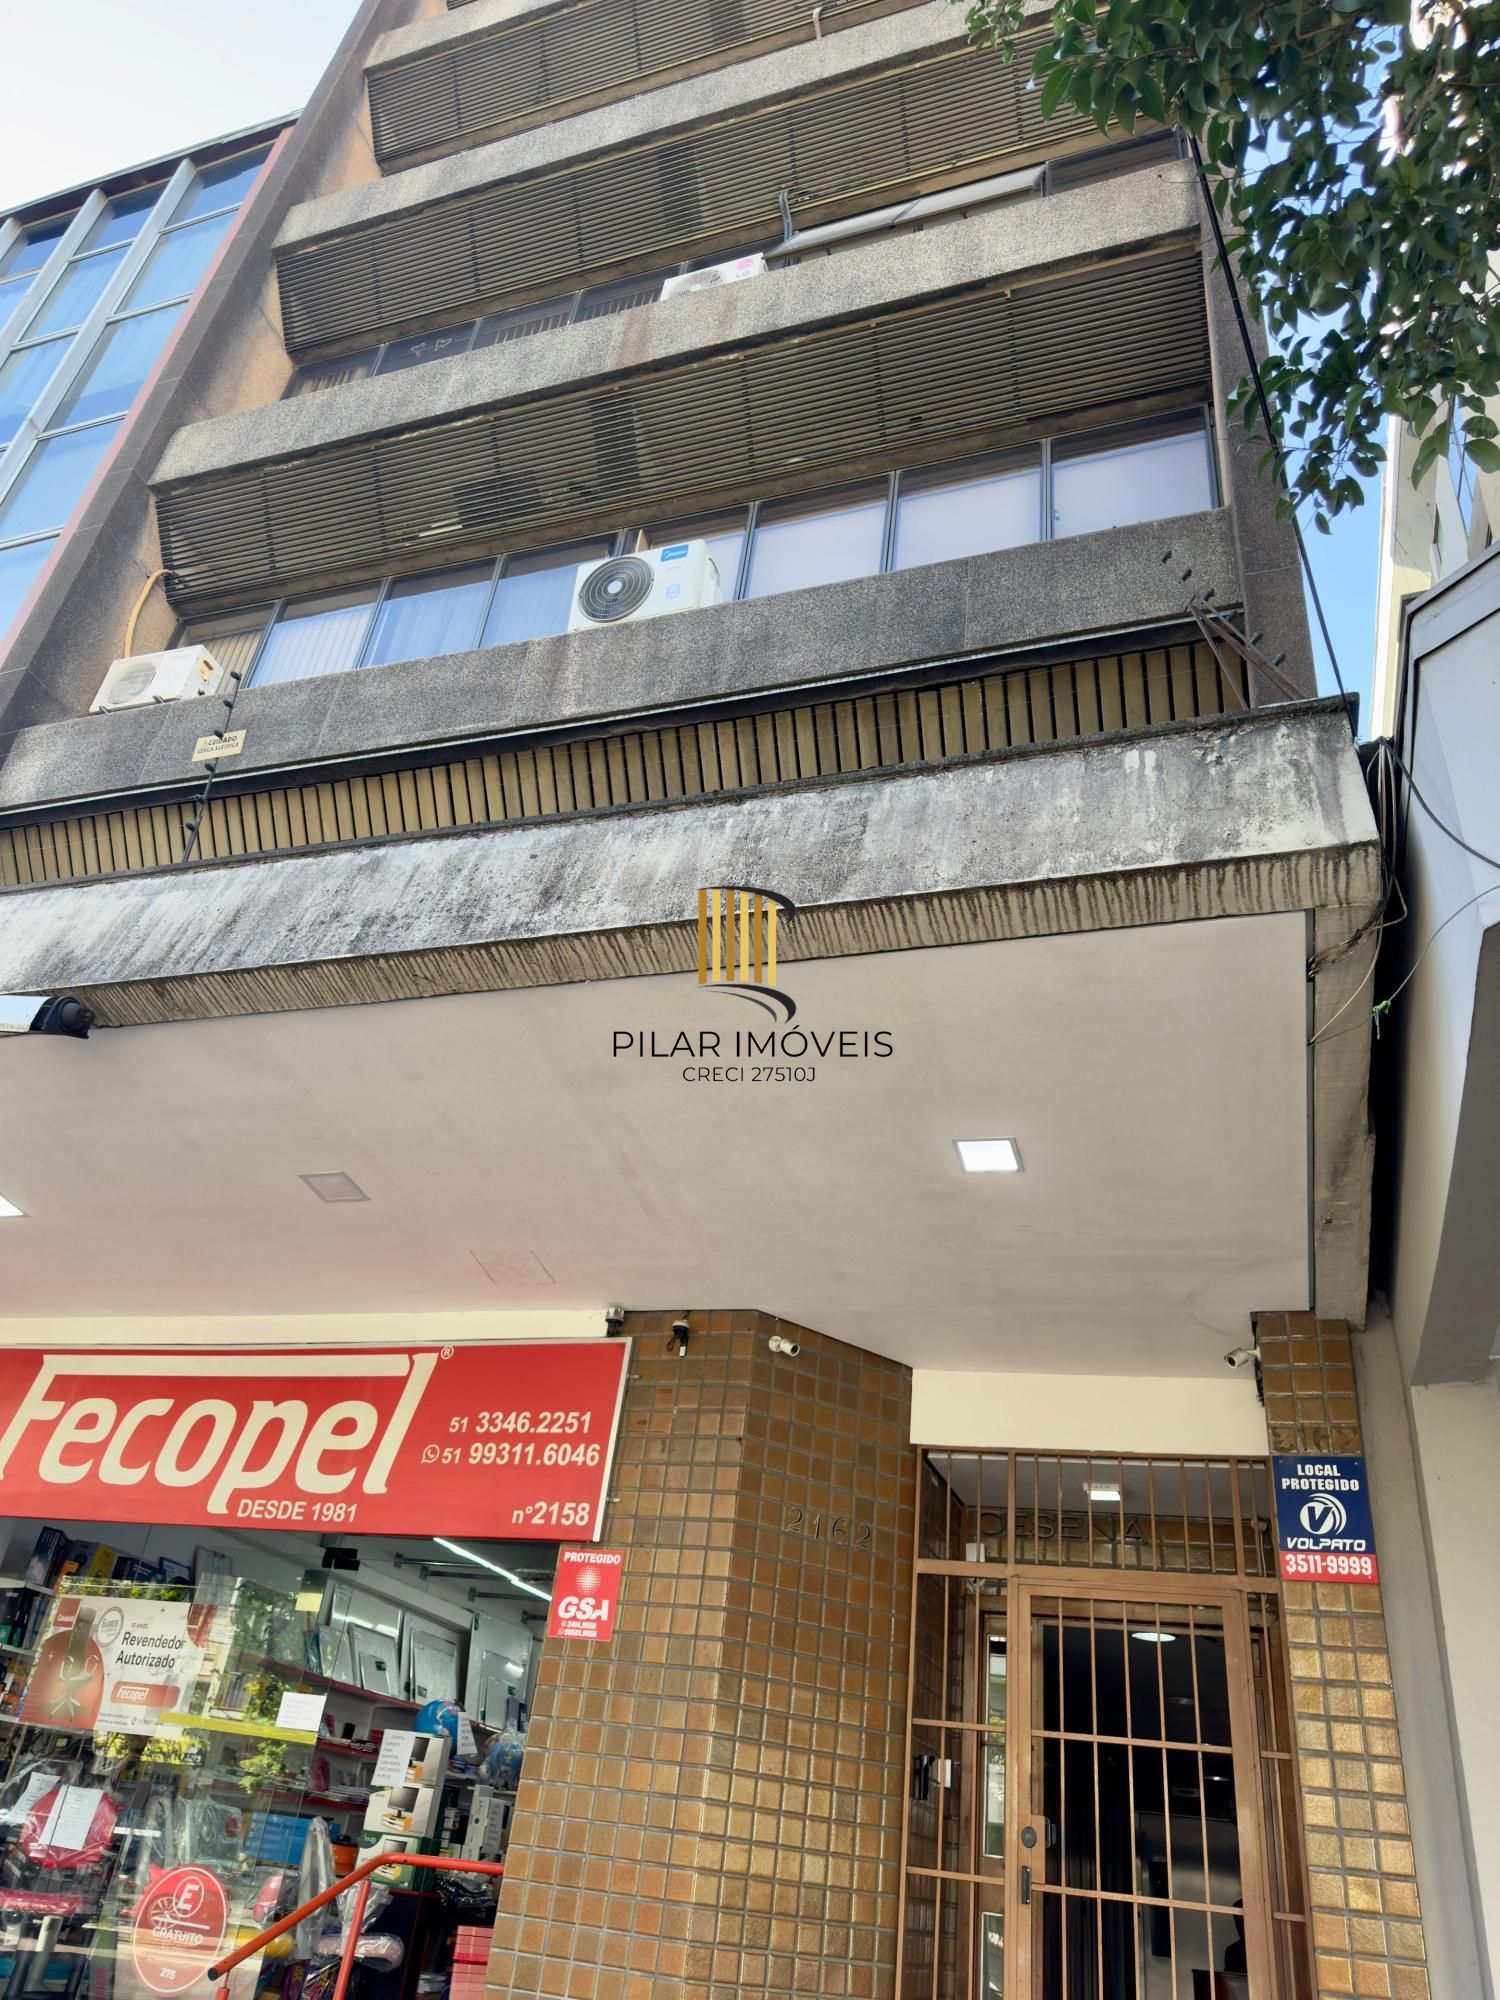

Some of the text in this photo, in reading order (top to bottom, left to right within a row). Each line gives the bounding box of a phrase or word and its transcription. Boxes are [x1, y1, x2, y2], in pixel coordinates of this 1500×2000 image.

[208, 735, 238, 746] CUIDADO
[0, 1353, 439, 1514] Fecopel
[449, 1411, 592, 1434] 51 3346.2251
[441, 1442, 601, 1467] 51 99311.6046
[1297, 1464, 1341, 1477] LOCAL
[1281, 1477, 1360, 1492] PROTEGIDO
[237, 1499, 358, 1522] DESDE 1981
[783, 1506, 872, 1549] 2162
[980, 1511, 1147, 1545] CESENA
[1286, 1537, 1367, 1552] VOLPATO
[563, 1551, 622, 1565] PROTEGIDO
[1285, 1554, 1373, 1576] 3511-9999
[558, 1596, 609, 1621] GSA
[121, 1631, 186, 1650] Revendedor
[115, 1650, 175, 1669] Autorizado
[177, 1883, 200, 1910] E
[152, 1926, 204, 1945] GRATUITO
